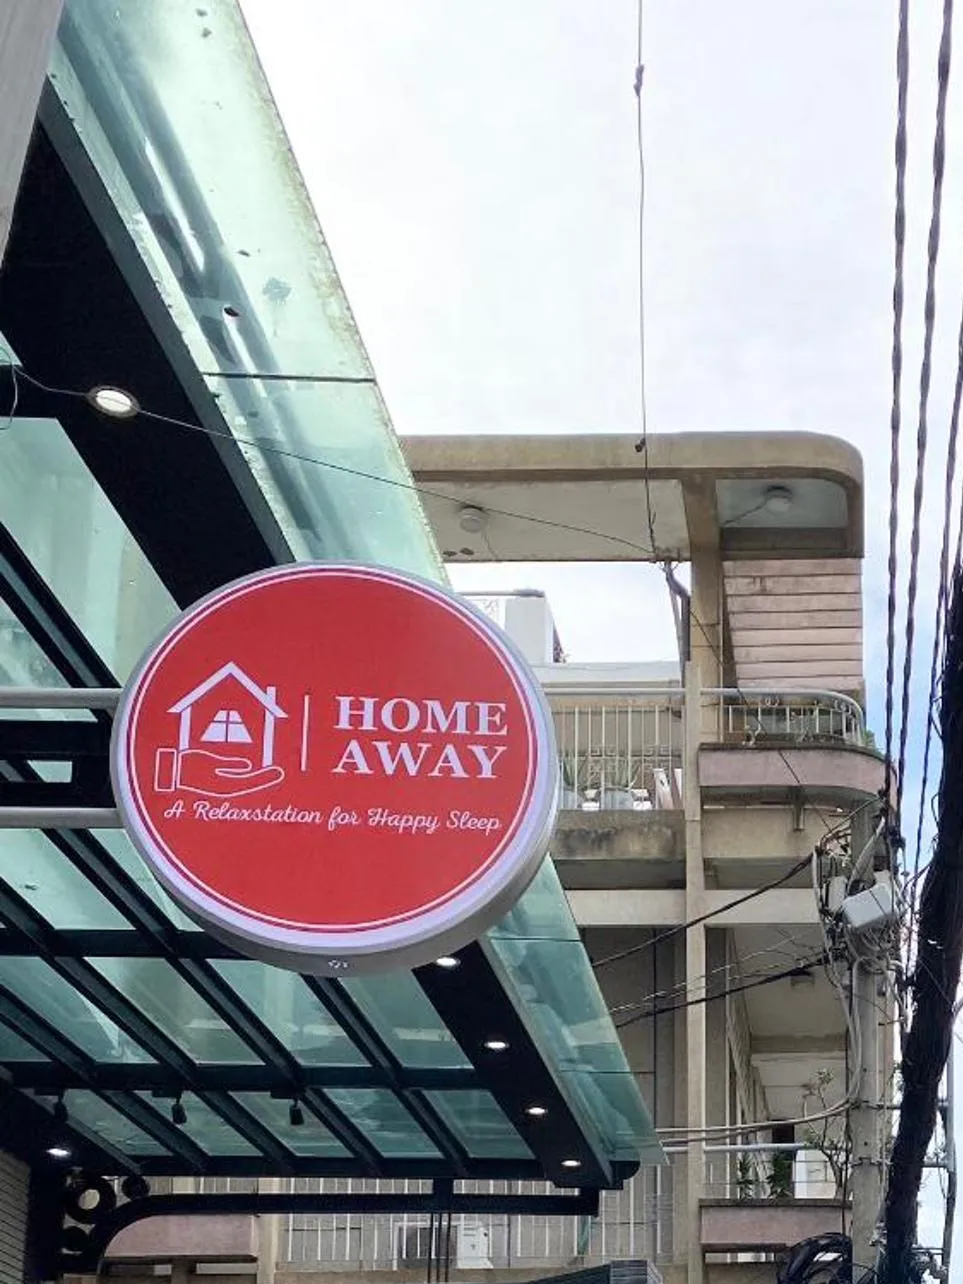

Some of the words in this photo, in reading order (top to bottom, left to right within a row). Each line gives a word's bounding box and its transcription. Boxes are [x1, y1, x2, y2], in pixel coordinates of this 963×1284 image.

[333, 696, 508, 736] HOME
[331, 739, 508, 778] AWAY
[163, 799, 185, 819] A
[193, 800, 323, 824] Relaxstation
[327, 805, 360, 831] for
[367, 807, 440, 834] Happy
[446, 809, 502, 836] Sleep
